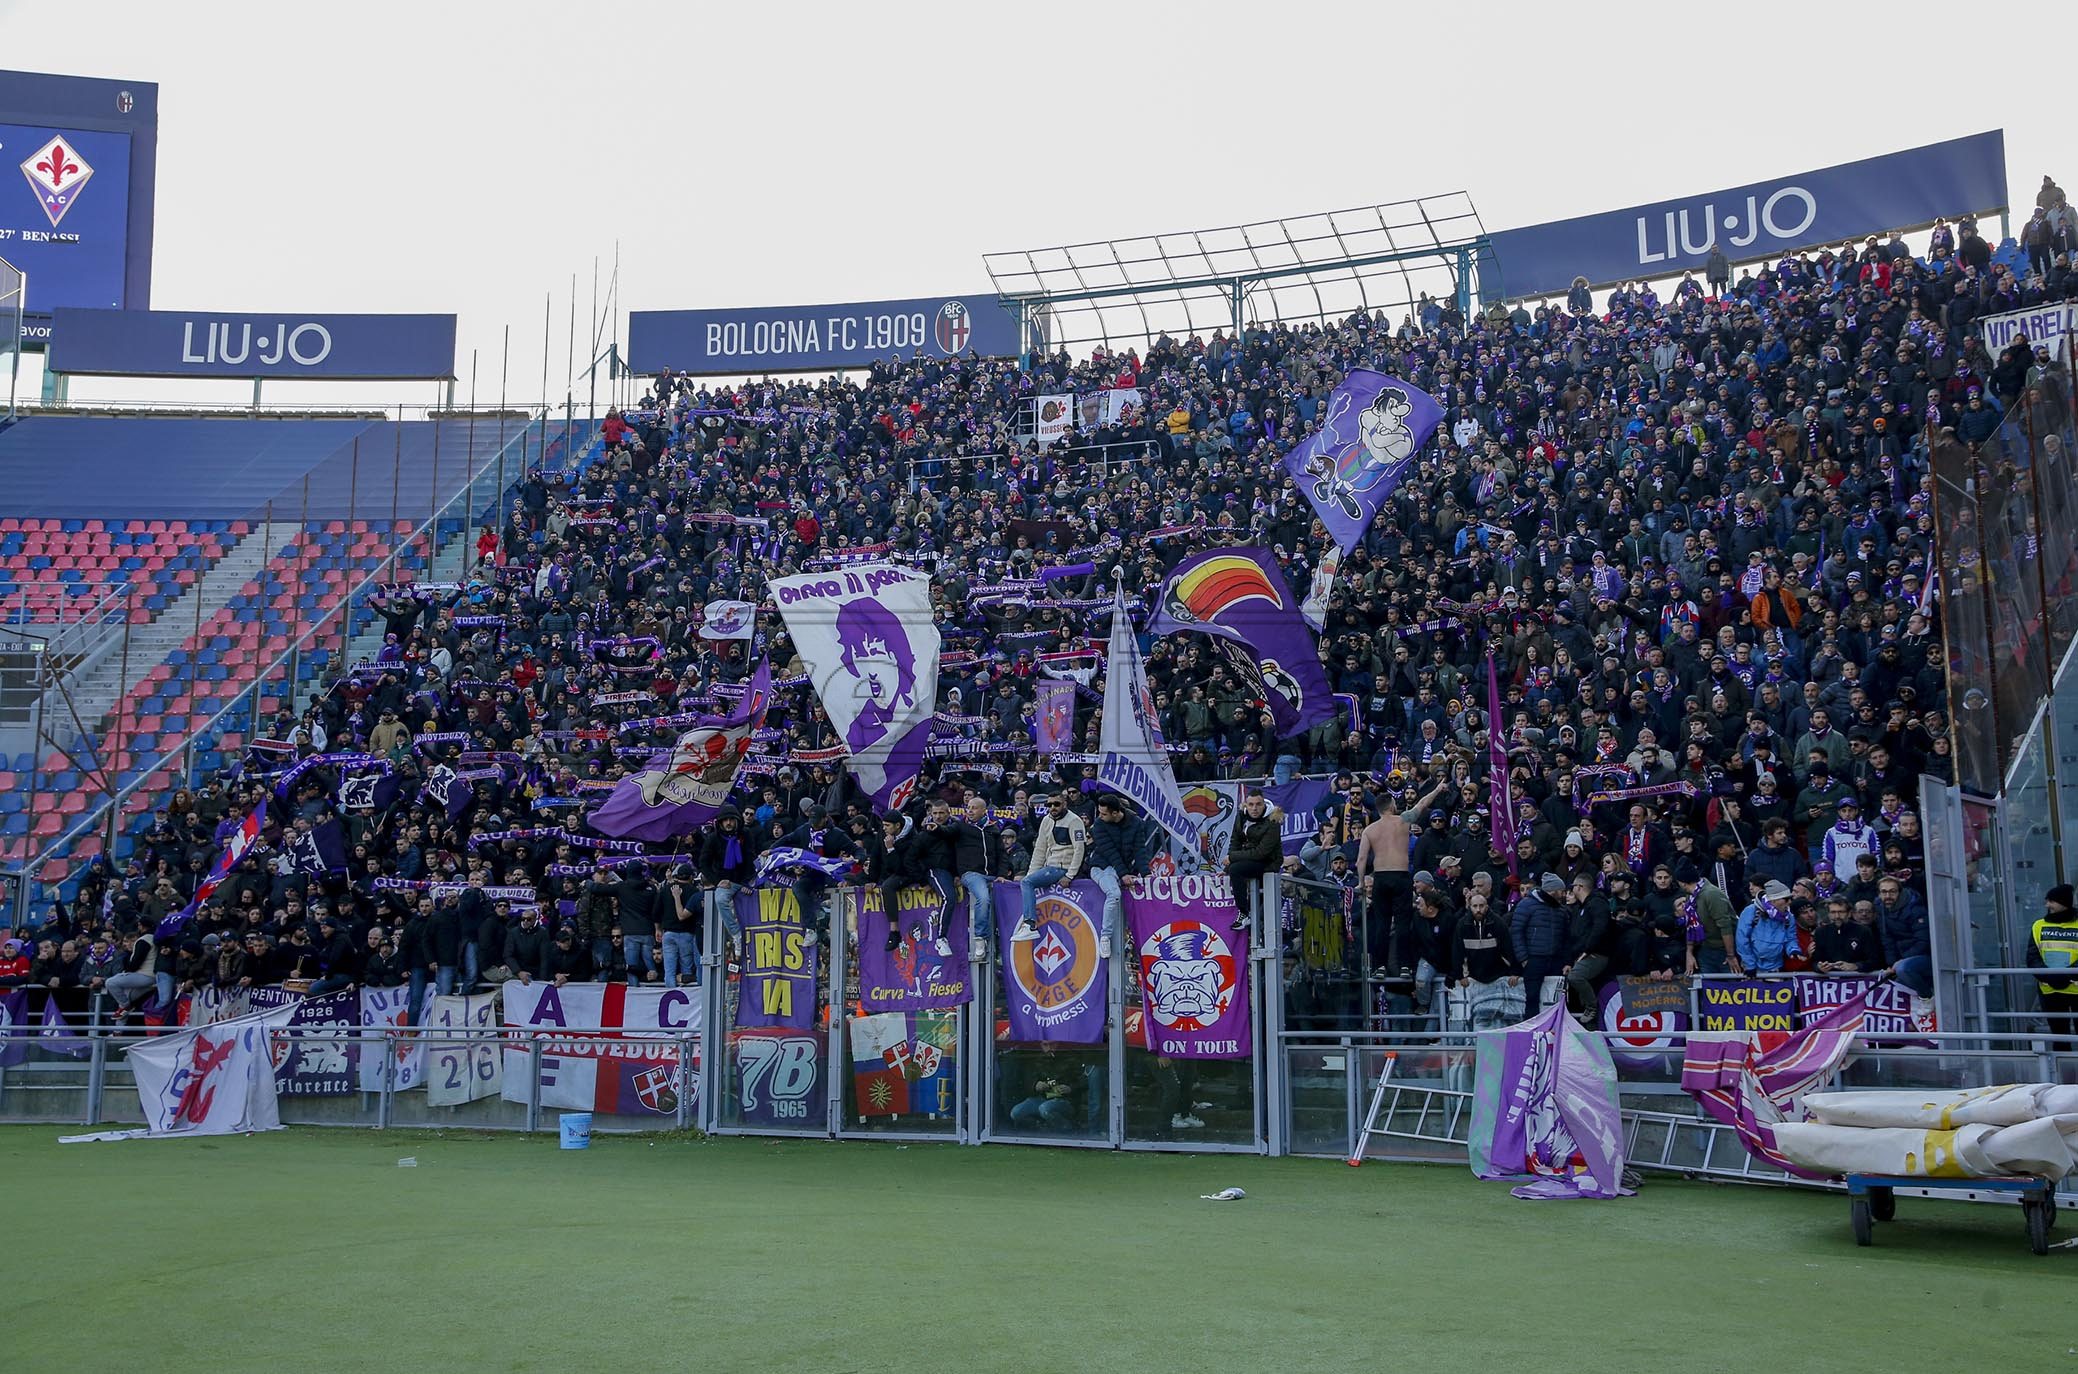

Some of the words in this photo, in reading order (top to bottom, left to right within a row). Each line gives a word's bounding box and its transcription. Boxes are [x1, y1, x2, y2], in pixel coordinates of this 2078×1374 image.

[944, 303, 962, 315] BFC
[706, 320, 820, 356] BOLOGNA
[828, 317, 857, 350] FC
[864, 312, 926, 349] 1909
[281, 759, 312, 785] SETTE
[1836, 841, 1868, 850] TOYOTA
[1204, 900, 1236, 908] VIOL
[870, 985, 905, 1001] Curva
[1639, 985, 1679, 996] CALCIO
[1706, 987, 1792, 1005] VACILLO
[1803, 978, 1906, 1011] FIRENZE
[1632, 996, 1685, 1009] MODERNO
[300, 1007, 333, 1018] 1926
[1707, 1014, 1735, 1031] MA
[1745, 1013, 1791, 1031] NON
[1163, 1039, 1186, 1054] ON
[1195, 1038, 1239, 1054] TOUR
[274, 1078, 349, 1095] Florence
[769, 1100, 807, 1118] 1965
